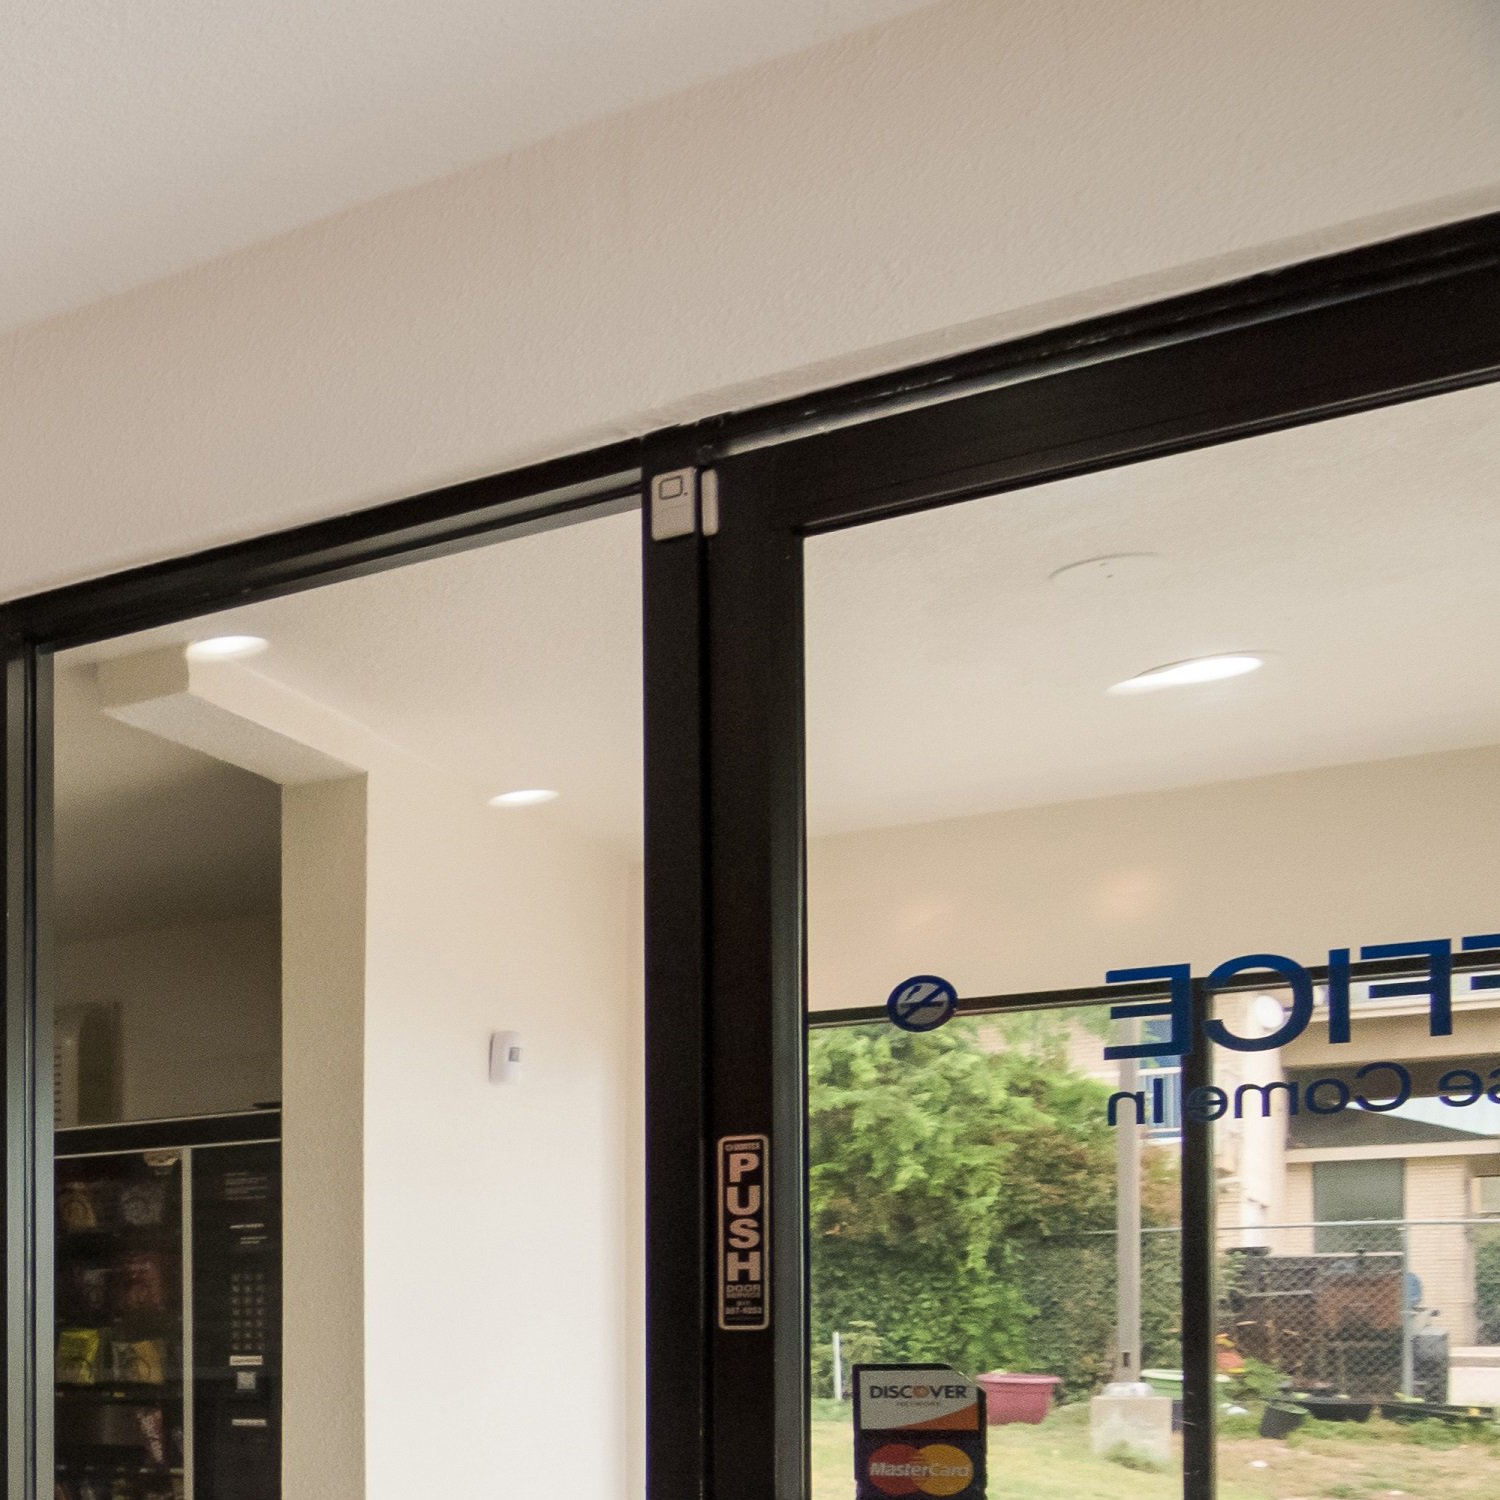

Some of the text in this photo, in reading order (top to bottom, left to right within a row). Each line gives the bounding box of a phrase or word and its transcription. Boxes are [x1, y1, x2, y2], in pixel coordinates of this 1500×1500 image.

[726, 1153, 761, 1282] PUSH
[870, 1385, 967, 1399] DISCOVER
[869, 1461, 970, 1478] MasterCard
